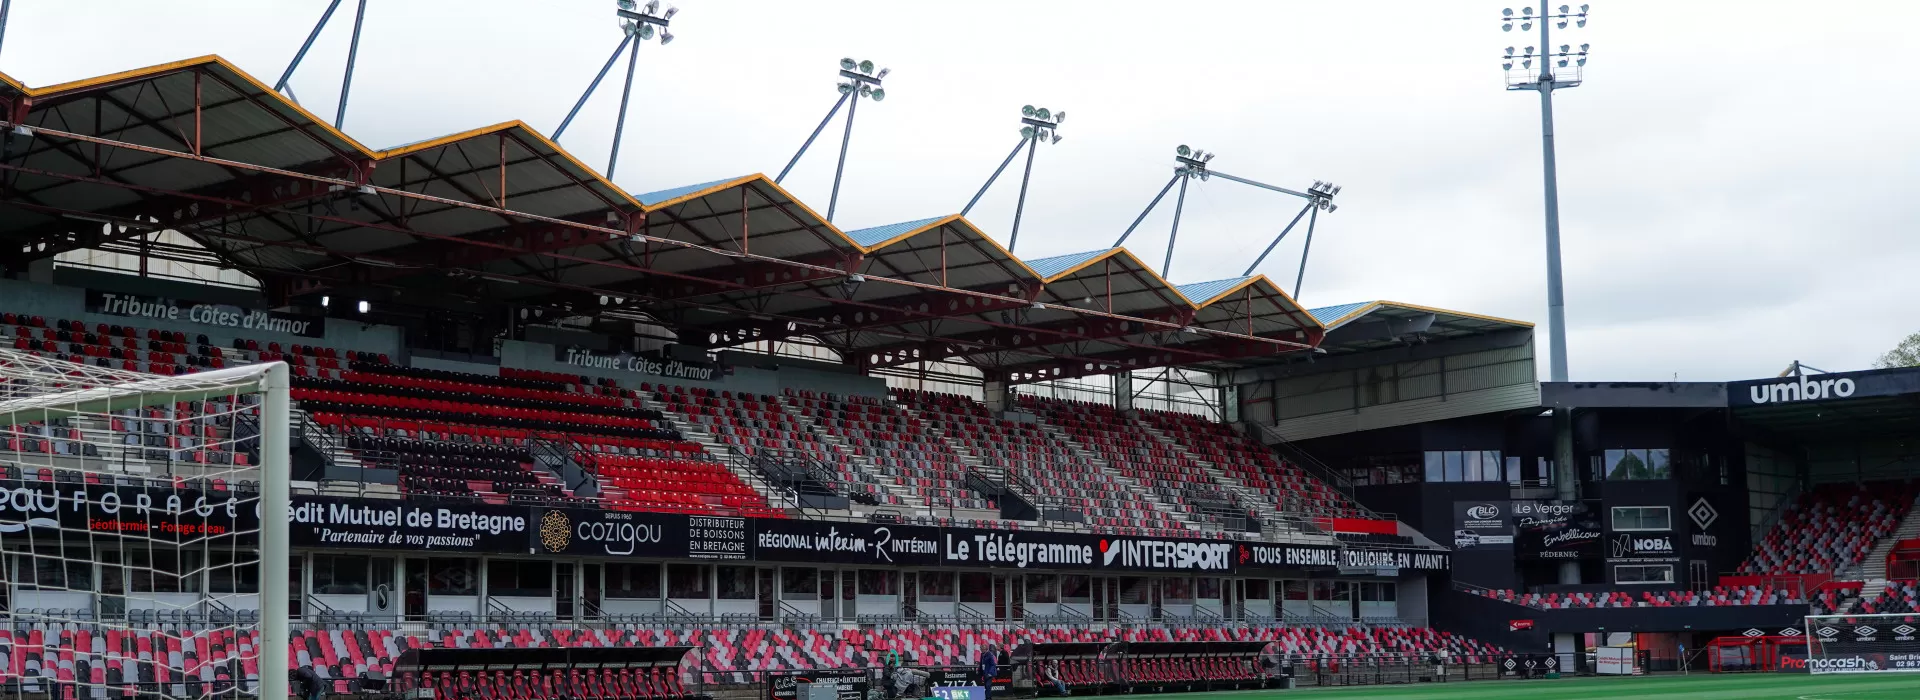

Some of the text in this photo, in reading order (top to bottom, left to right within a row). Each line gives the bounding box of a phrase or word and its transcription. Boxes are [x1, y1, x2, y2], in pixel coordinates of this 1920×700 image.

[102, 293, 310, 335] Tribune Côtes d'Armor
[567, 349, 713, 380] Tribune Côtes d'Armor
[1750, 375, 1856, 404] umbro
[73, 490, 238, 518] FORAGE
[1478, 506, 1495, 514] BLC
[1517, 503, 1574, 516] Le Verger
[88, 517, 149, 532] Géothermie
[160, 521, 195, 535] Forage
[197, 523, 226, 534] deau
[329, 503, 401, 527] Mutuel
[406, 508, 433, 528] de
[437, 508, 525, 535] Bretagne
[689, 518, 745, 529] DISTRIBUTEUR
[388, 530, 403, 544] de
[406, 535, 424, 545] vos
[689, 528, 745, 540] DE BOISSONS
[1692, 532, 1717, 546] umbro
[689, 540, 745, 551] EN BRETAGNE
[758, 530, 812, 549] RÉGIONAL
[873, 527, 893, 562] R
[892, 537, 937, 554] INTÉRIM
[946, 533, 1092, 568] Le Télégramme
[1122, 540, 1231, 570] INTERSPORT
[1253, 547, 1281, 564] TOUS
[1286, 547, 1339, 568] ENSEMBLE,
[1344, 550, 1394, 567] TOUJOURS
[1397, 553, 1410, 569] EN
[1414, 554, 1443, 570] AVANT
[1539, 550, 1579, 558] PÉDERNEC
[1781, 655, 1866, 669] Promocash
[951, 690, 969, 698] BKT
